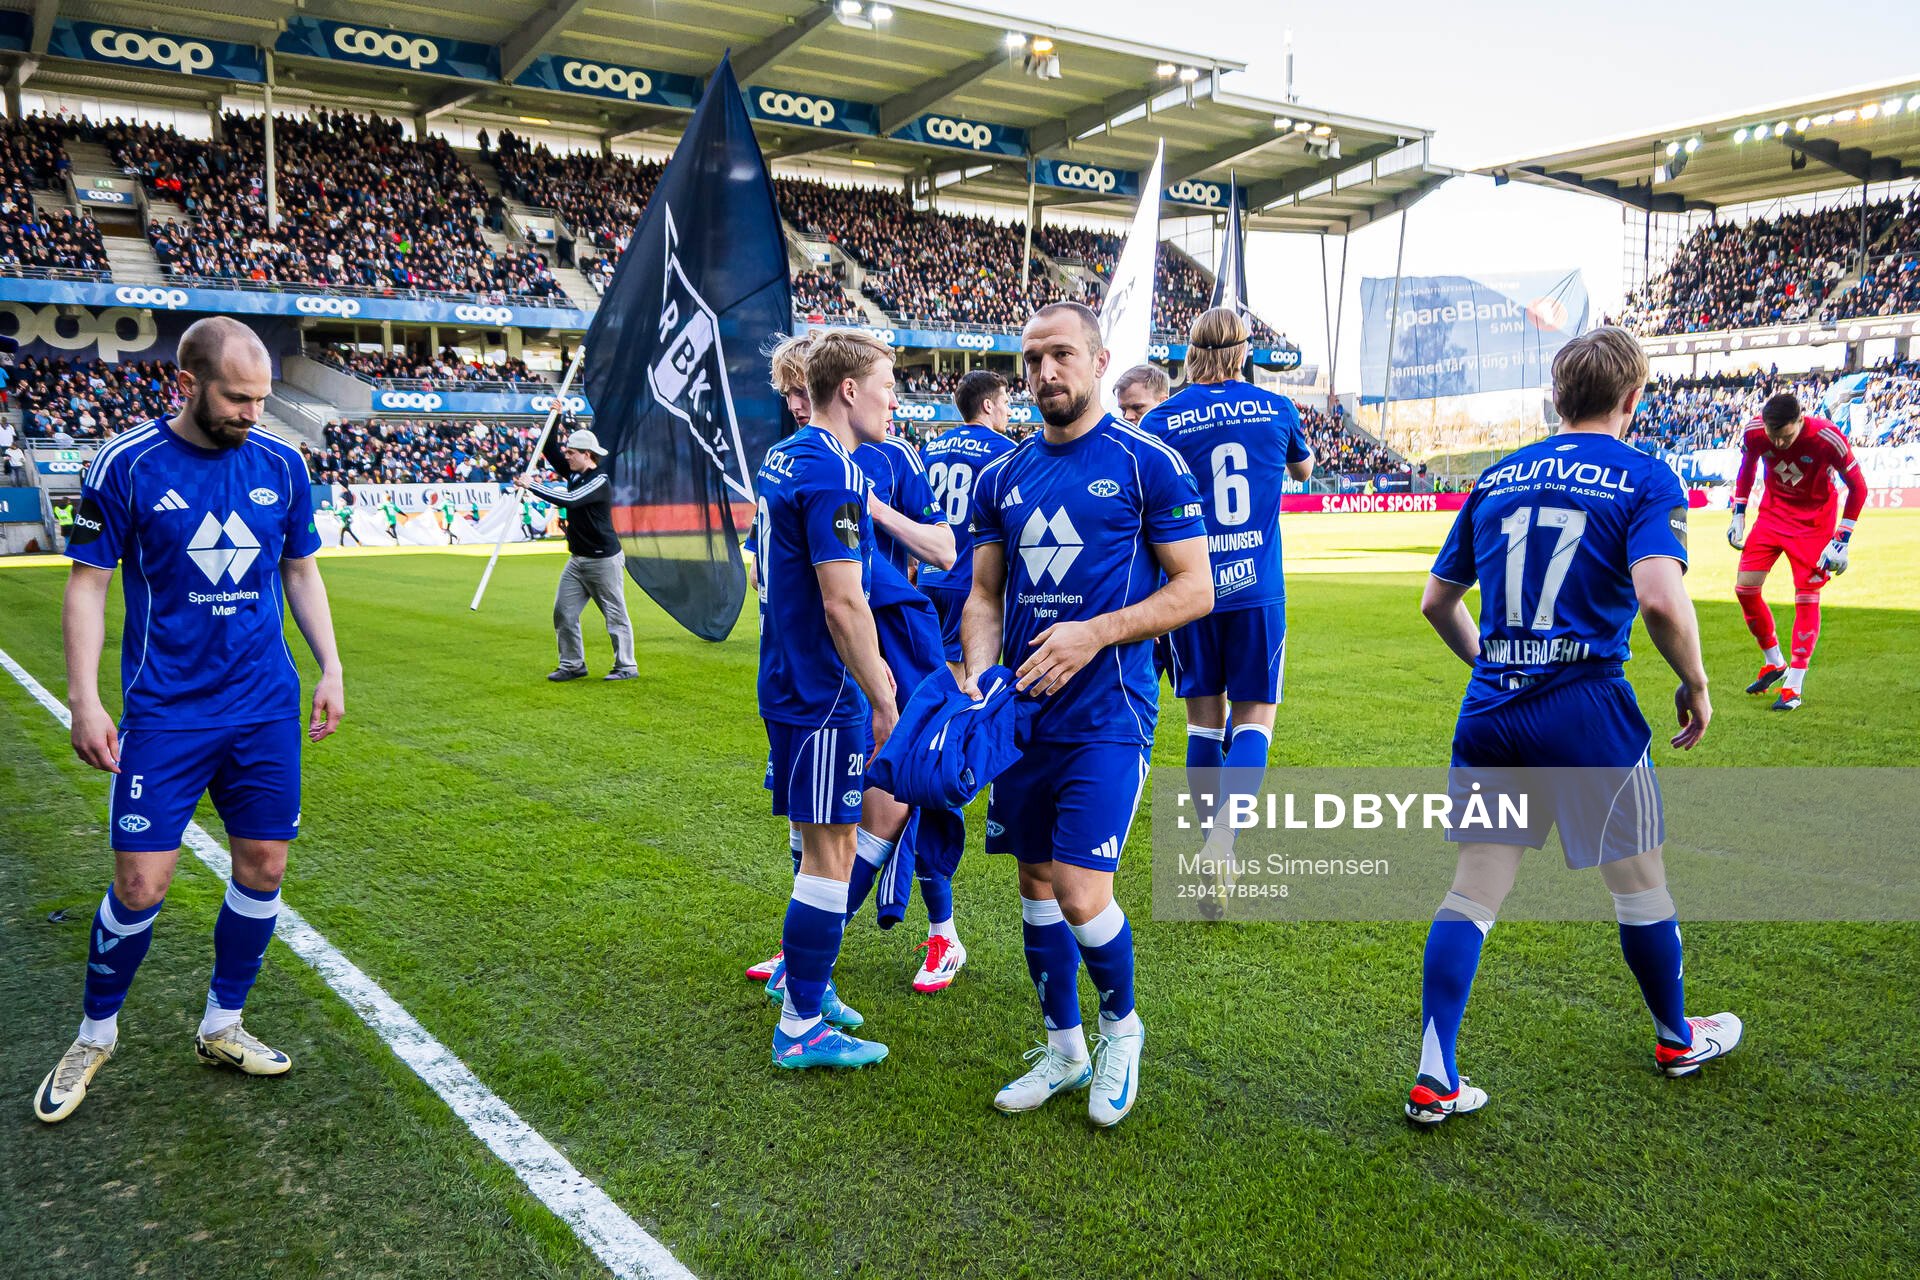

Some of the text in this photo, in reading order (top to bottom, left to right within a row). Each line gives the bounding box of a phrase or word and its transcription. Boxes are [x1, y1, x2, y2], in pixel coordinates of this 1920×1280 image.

[90, 29, 214, 75] coop
[333, 27, 439, 70] coop
[563, 61, 653, 100] coop
[759, 91, 835, 127] coop
[926, 117, 992, 150] coop
[1057, 163, 1116, 193] coop
[87, 190, 124, 203] coop
[1168, 181, 1221, 207] coop
[115, 286, 189, 310] coop
[296, 296, 361, 319] coop
[454, 304, 514, 327] coop
[1385, 295, 1523, 332] SpareBank
[1490, 321, 1525, 335] SMN
[956, 333, 995, 350] coop
[1270, 350, 1299, 366] coop
[381, 392, 443, 413] coop
[896, 404, 936, 421] coop
[1166, 400, 1279, 431] BRUNVOLL
[1178, 423, 1215, 436] PRECISION
[1226, 418, 1241, 426] OUR
[1243, 416, 1271, 424] PASSION
[926, 437, 992, 454] BRUNVOLL
[1210, 442, 1251, 526] 6
[1478, 457, 1635, 493] BRUNVOLL
[928, 462, 973, 525] 28
[1487, 484, 1530, 498] PRECISION
[1544, 482, 1567, 492] OUR
[1570, 486, 1616, 500] PASSION
[1321, 494, 1437, 513] SCANDIC SPORTS
[1219, 560, 1253, 586] MOT
[1501, 505, 1588, 631] 17
[188, 590, 260, 605] Sparebanken
[1018, 592, 1083, 605] Sparebanken
[212, 604, 237, 616] Møre
[1034, 607, 1058, 618] Møre
[847, 753, 864, 776] 20
[130, 774, 144, 800] 5
